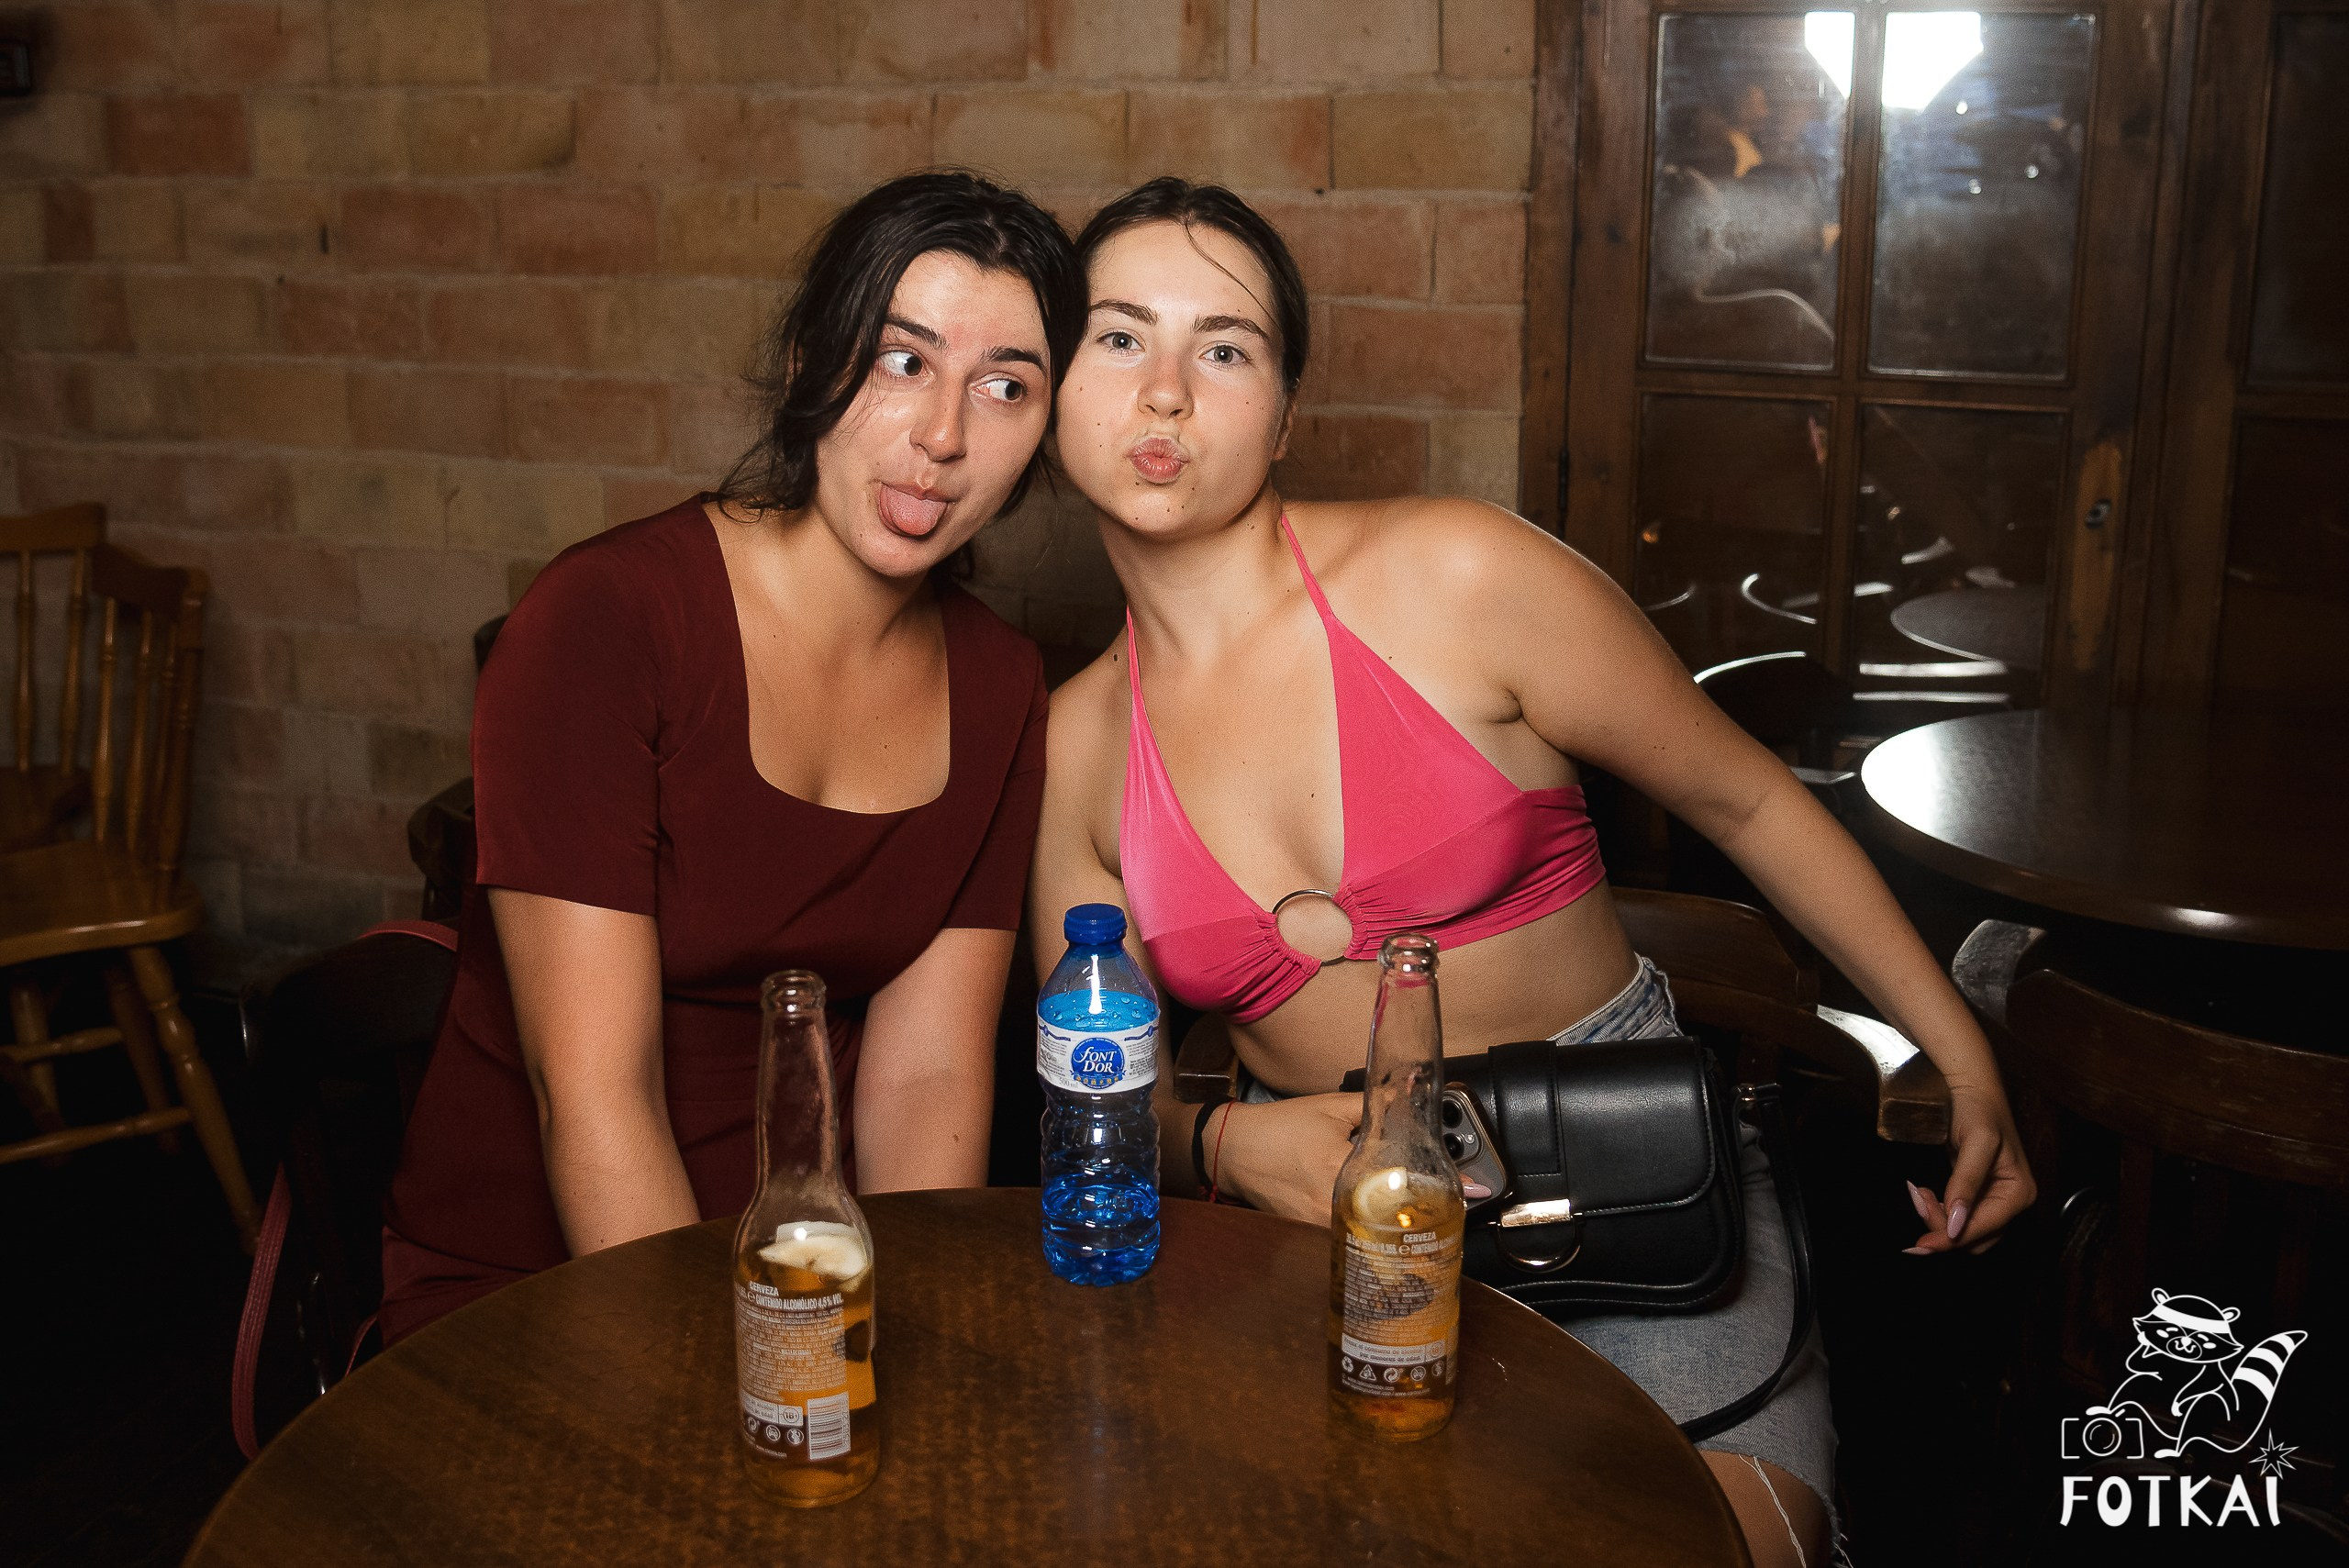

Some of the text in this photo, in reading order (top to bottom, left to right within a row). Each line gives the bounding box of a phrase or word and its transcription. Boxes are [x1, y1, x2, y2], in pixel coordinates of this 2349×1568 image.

[1073, 1046, 1118, 1062] FONT
[1403, 1231, 1436, 1243] CERVEZA
[750, 1280, 779, 1296] CERVEZA
[755, 1293, 783, 1309] CONTENIDO
[783, 1296, 818, 1310] ALCOHÓLICO
